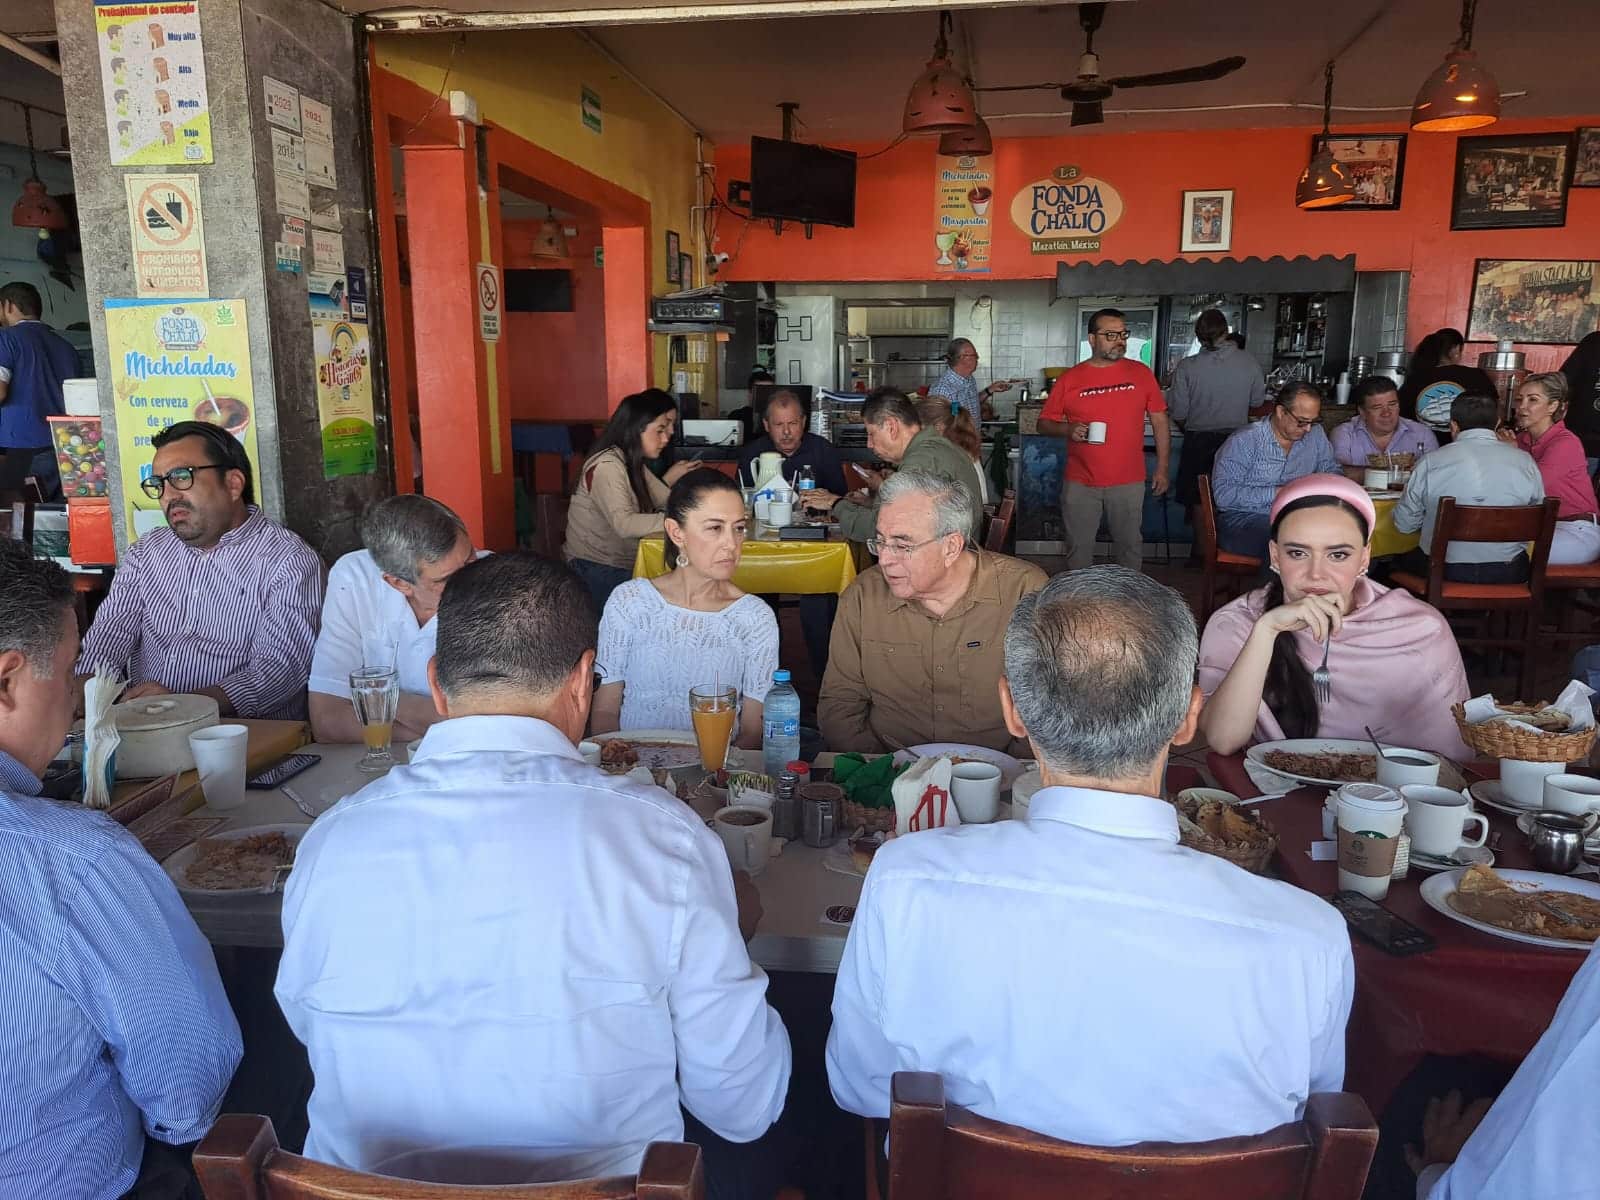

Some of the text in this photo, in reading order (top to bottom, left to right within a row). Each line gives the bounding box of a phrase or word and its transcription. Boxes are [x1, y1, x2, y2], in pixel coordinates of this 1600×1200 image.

[167, 31, 196, 42] Muy alta
[178, 65, 192, 74] Alta
[177, 99, 199, 108] Media
[942, 170, 989, 181] Micheladas
[1060, 167, 1077, 178] La
[1031, 184, 1104, 210] FONDA
[1056, 202, 1075, 215] de
[941, 215, 988, 228] Margaritas
[1030, 209, 1106, 235] CHALIO
[1071, 240, 1100, 250] México
[160, 317, 199, 330] FONDA
[162, 329, 201, 343] CHALIO
[125, 352, 237, 380] Micheladas
[129, 395, 189, 409] Con cerveza
[147, 414, 159, 427] de
